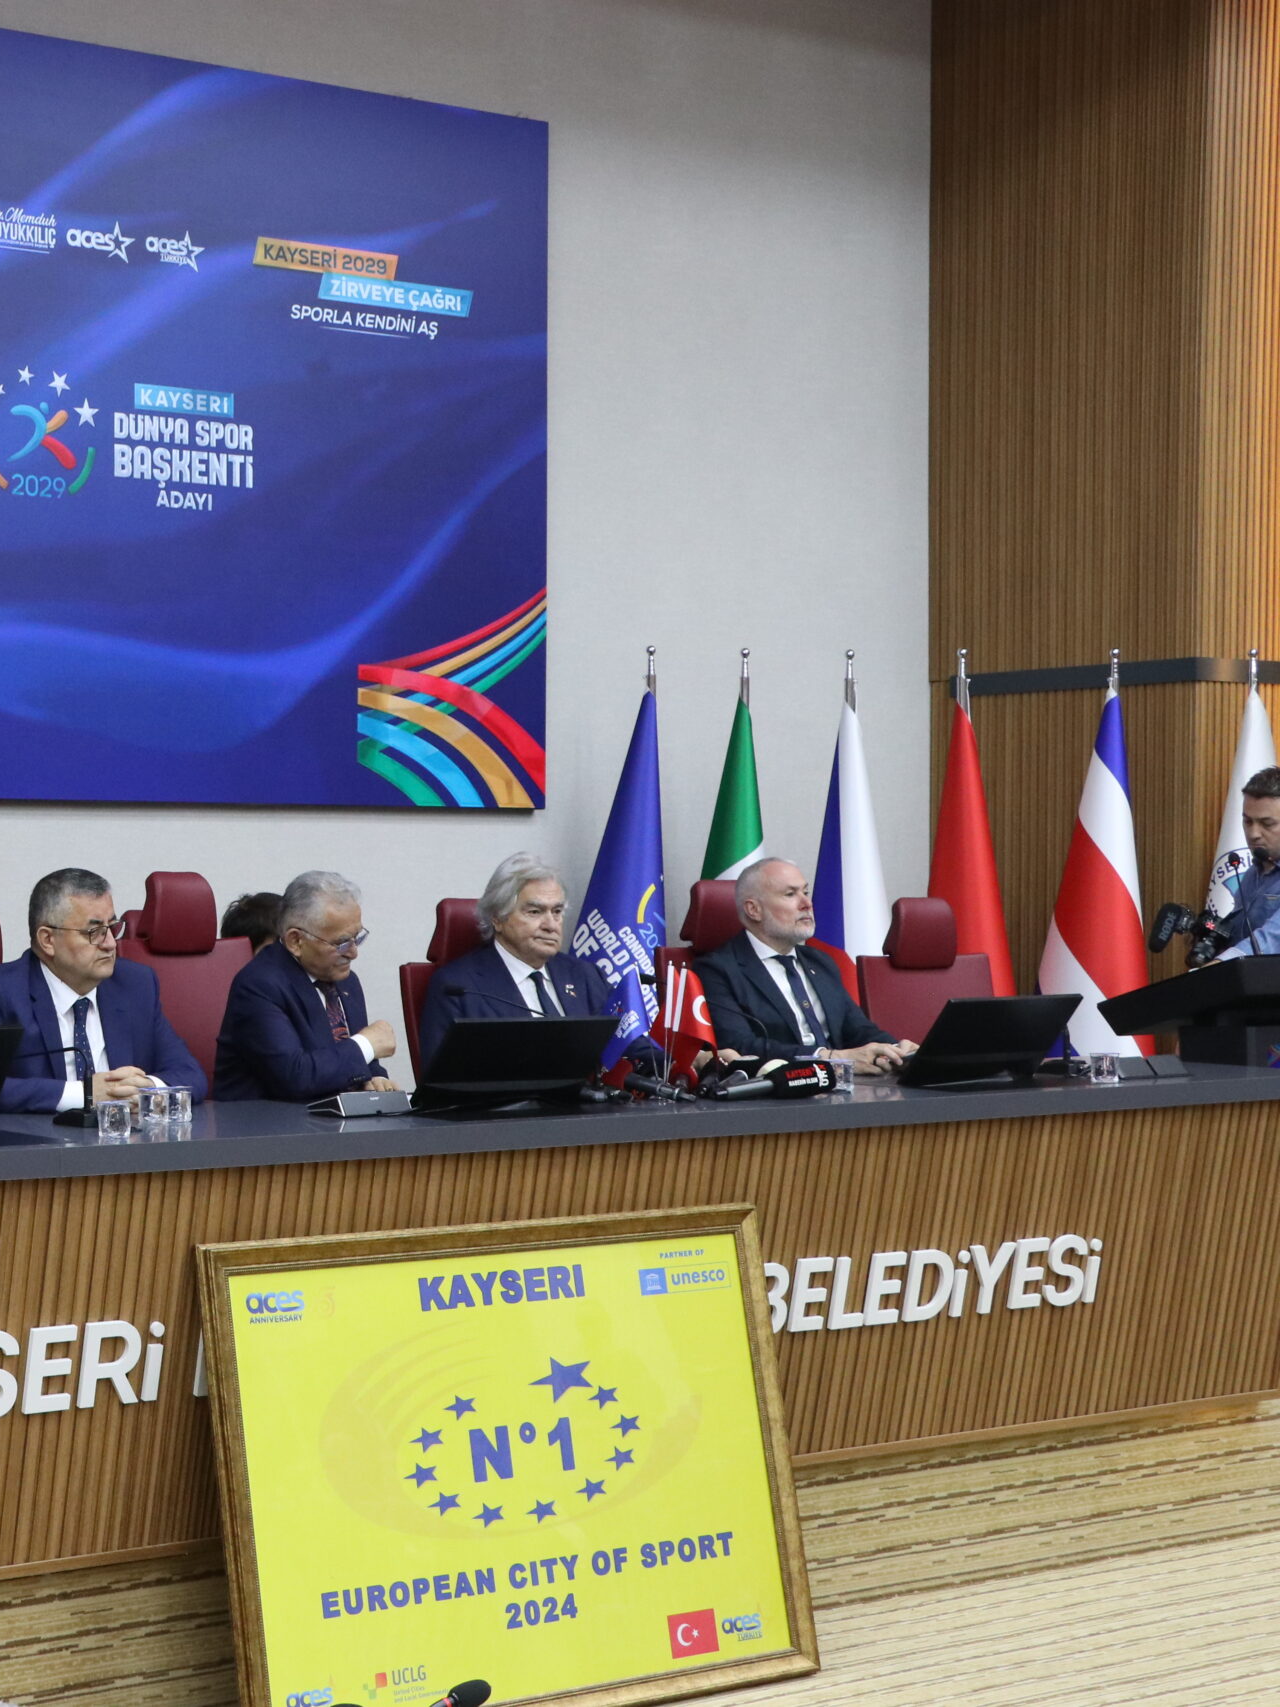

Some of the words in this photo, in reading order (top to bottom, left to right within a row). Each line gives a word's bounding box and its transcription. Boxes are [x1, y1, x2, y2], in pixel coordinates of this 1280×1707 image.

[5, 207, 57, 227] Memduh
[66, 228, 115, 251] aces
[145, 236, 187, 256] aces
[263, 244, 337, 269] KAYSERİ
[342, 254, 388, 275] 2029
[330, 276, 405, 304] ZİRVEYE
[408, 289, 462, 311] ÇAĞRI
[290, 304, 352, 326] SPORLA
[355, 312, 416, 333] KENDİNİ
[418, 321, 439, 340] AŞ
[114, 412, 189, 445] DÜNYA
[195, 420, 253, 451] SPOR
[11, 473, 66, 499] 2029
[156, 490, 213, 511] ADAYI
[573, 923, 600, 959] OF
[587, 908, 630, 966] WORLD
[659, 1250, 693, 1259] PARTNER
[418, 1264, 585, 1312] KAYSERI
[671, 1269, 725, 1286] unesco
[245, 1290, 305, 1314] aces
[249, 1313, 303, 1325] ANNIVERSARY
[320, 1567, 496, 1619] EUROPEAN
[508, 1554, 579, 1590] CITY
[591, 1547, 628, 1576] OF
[641, 1531, 734, 1568] SPORT
[505, 1593, 578, 1629] 2024
[722, 1613, 762, 1634] aces
[392, 1665, 426, 1686] UCLG
[286, 1687, 333, 1707] aces
